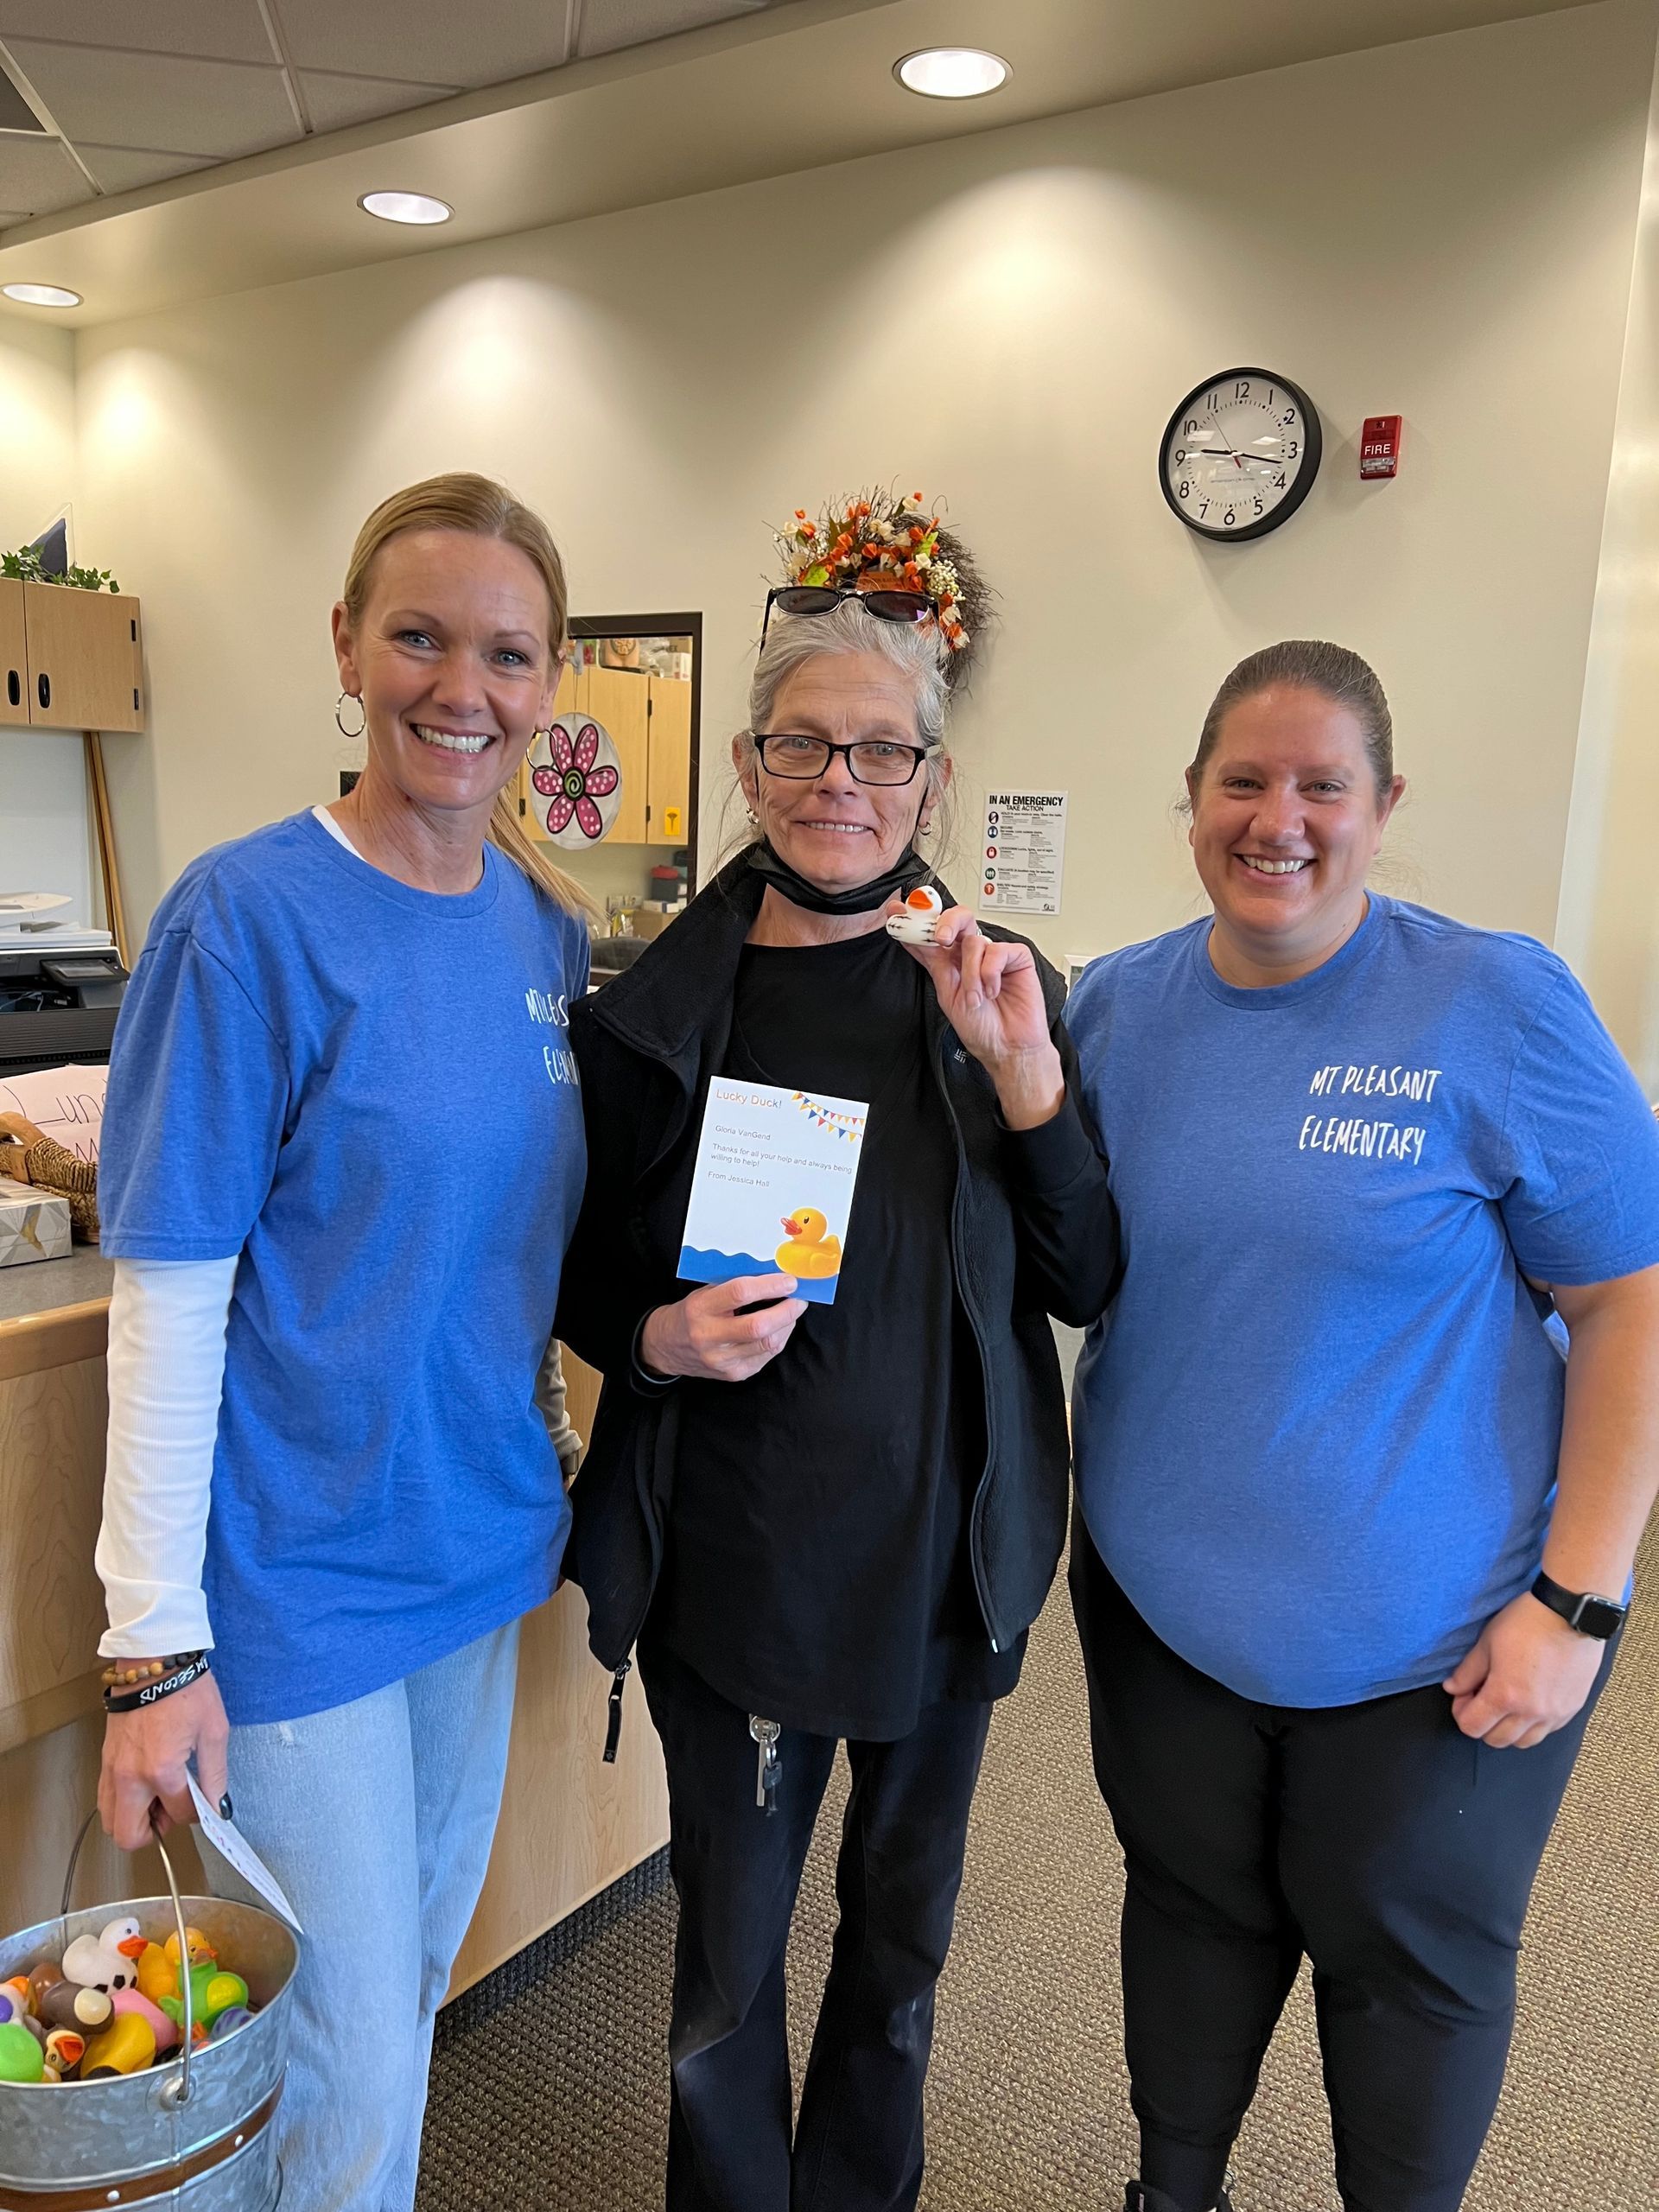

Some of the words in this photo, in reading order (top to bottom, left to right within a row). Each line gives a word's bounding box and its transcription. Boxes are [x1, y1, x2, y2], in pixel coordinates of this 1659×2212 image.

[1236, 382, 1249, 398] 12
[1268, 389, 1274, 404] 1
[1207, 393, 1217, 410] 11
[1285, 408, 1295, 424] 2
[1184, 420, 1198, 435] 10
[1287, 442, 1298, 459] 3
[1364, 443, 1391, 455] FIRE
[1175, 449, 1186, 467] 9
[1274, 471, 1287, 489] 4
[1179, 480, 1190, 499] 8
[1199, 504, 1209, 519] 7
[1253, 499, 1263, 516] 5
[1224, 508, 1236, 525] 6
[989, 795, 997, 804] IN
[999, 795, 1010, 804] AN
[1013, 796, 1064, 806] EMERGENCY
[1309, 1065, 1343, 1096] MT
[1341, 1065, 1443, 1103] PLEASANT
[716, 1089, 747, 1105] Lucky
[750, 1094, 782, 1109] Duck!
[715, 1125, 736, 1135] Gloria
[738, 1128, 771, 1141] VanGend
[1299, 1115, 1426, 1166] ELEMENTARY
[710, 1154, 733, 1165] willing
[742, 1158, 760, 1168] help!
[713, 1143, 738, 1154] Thanks
[740, 1147, 750, 1156] for
[750, 1149, 760, 1158] all
[760, 1152, 776, 1162] your
[778, 1154, 792, 1164] help
[793, 1157, 807, 1166] and
[808, 1159, 832, 1172] always
[833, 1164, 853, 1175] being
[708, 1171, 727, 1181] From
[728, 1174, 754, 1185] Jessica
[140, 1663, 195, 1701] SECOND
